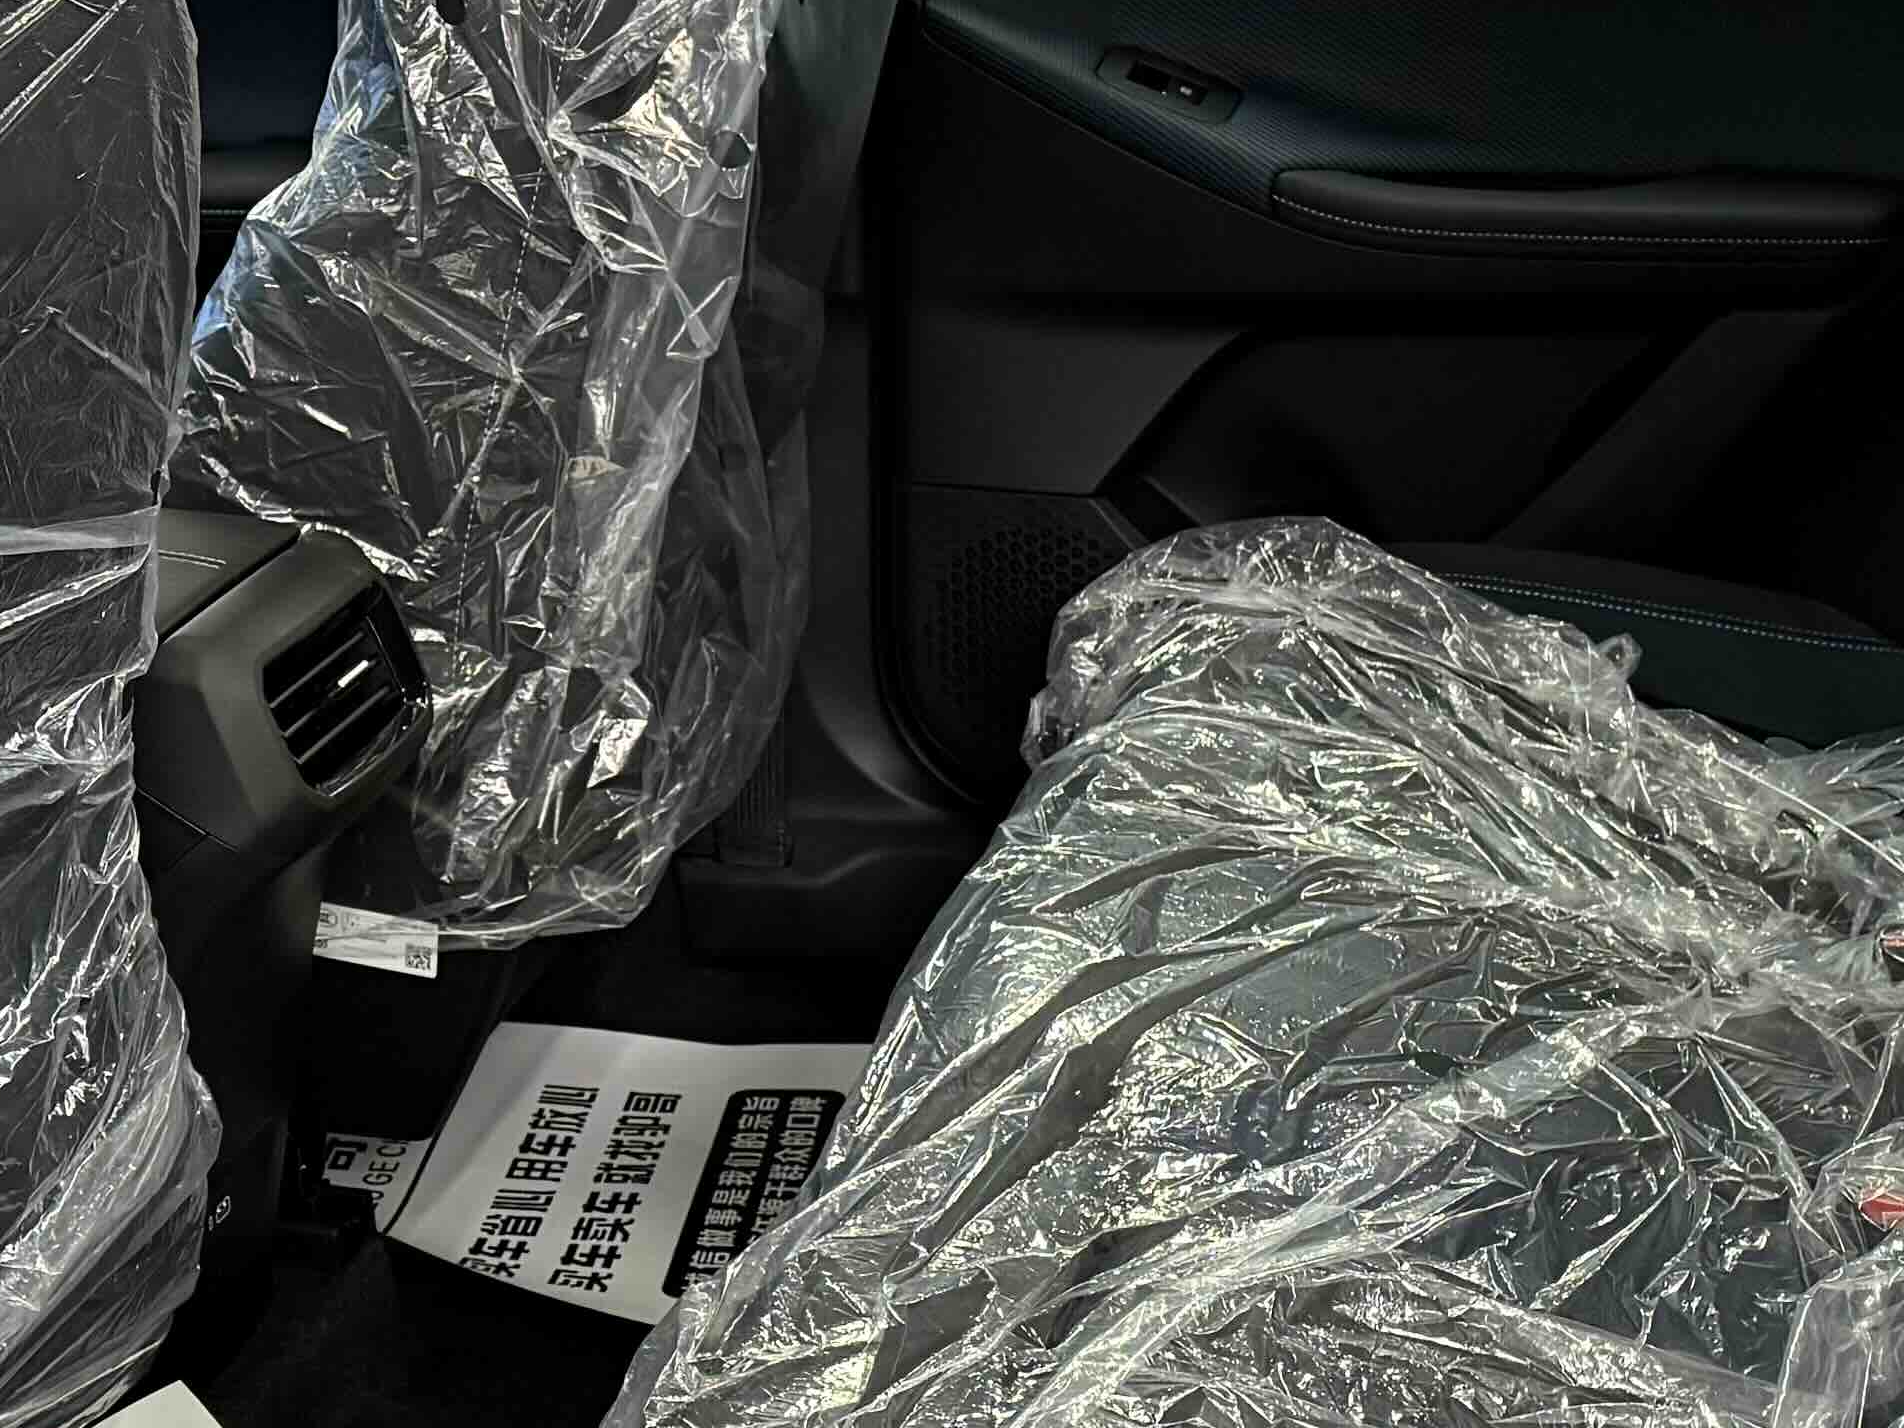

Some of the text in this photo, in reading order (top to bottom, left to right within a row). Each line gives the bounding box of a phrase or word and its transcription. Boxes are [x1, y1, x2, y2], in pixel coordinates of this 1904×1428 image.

[505, 1084, 600, 1182] 用车放心
[547, 1091, 683, 1293] 买车卖车 就找驴哥
